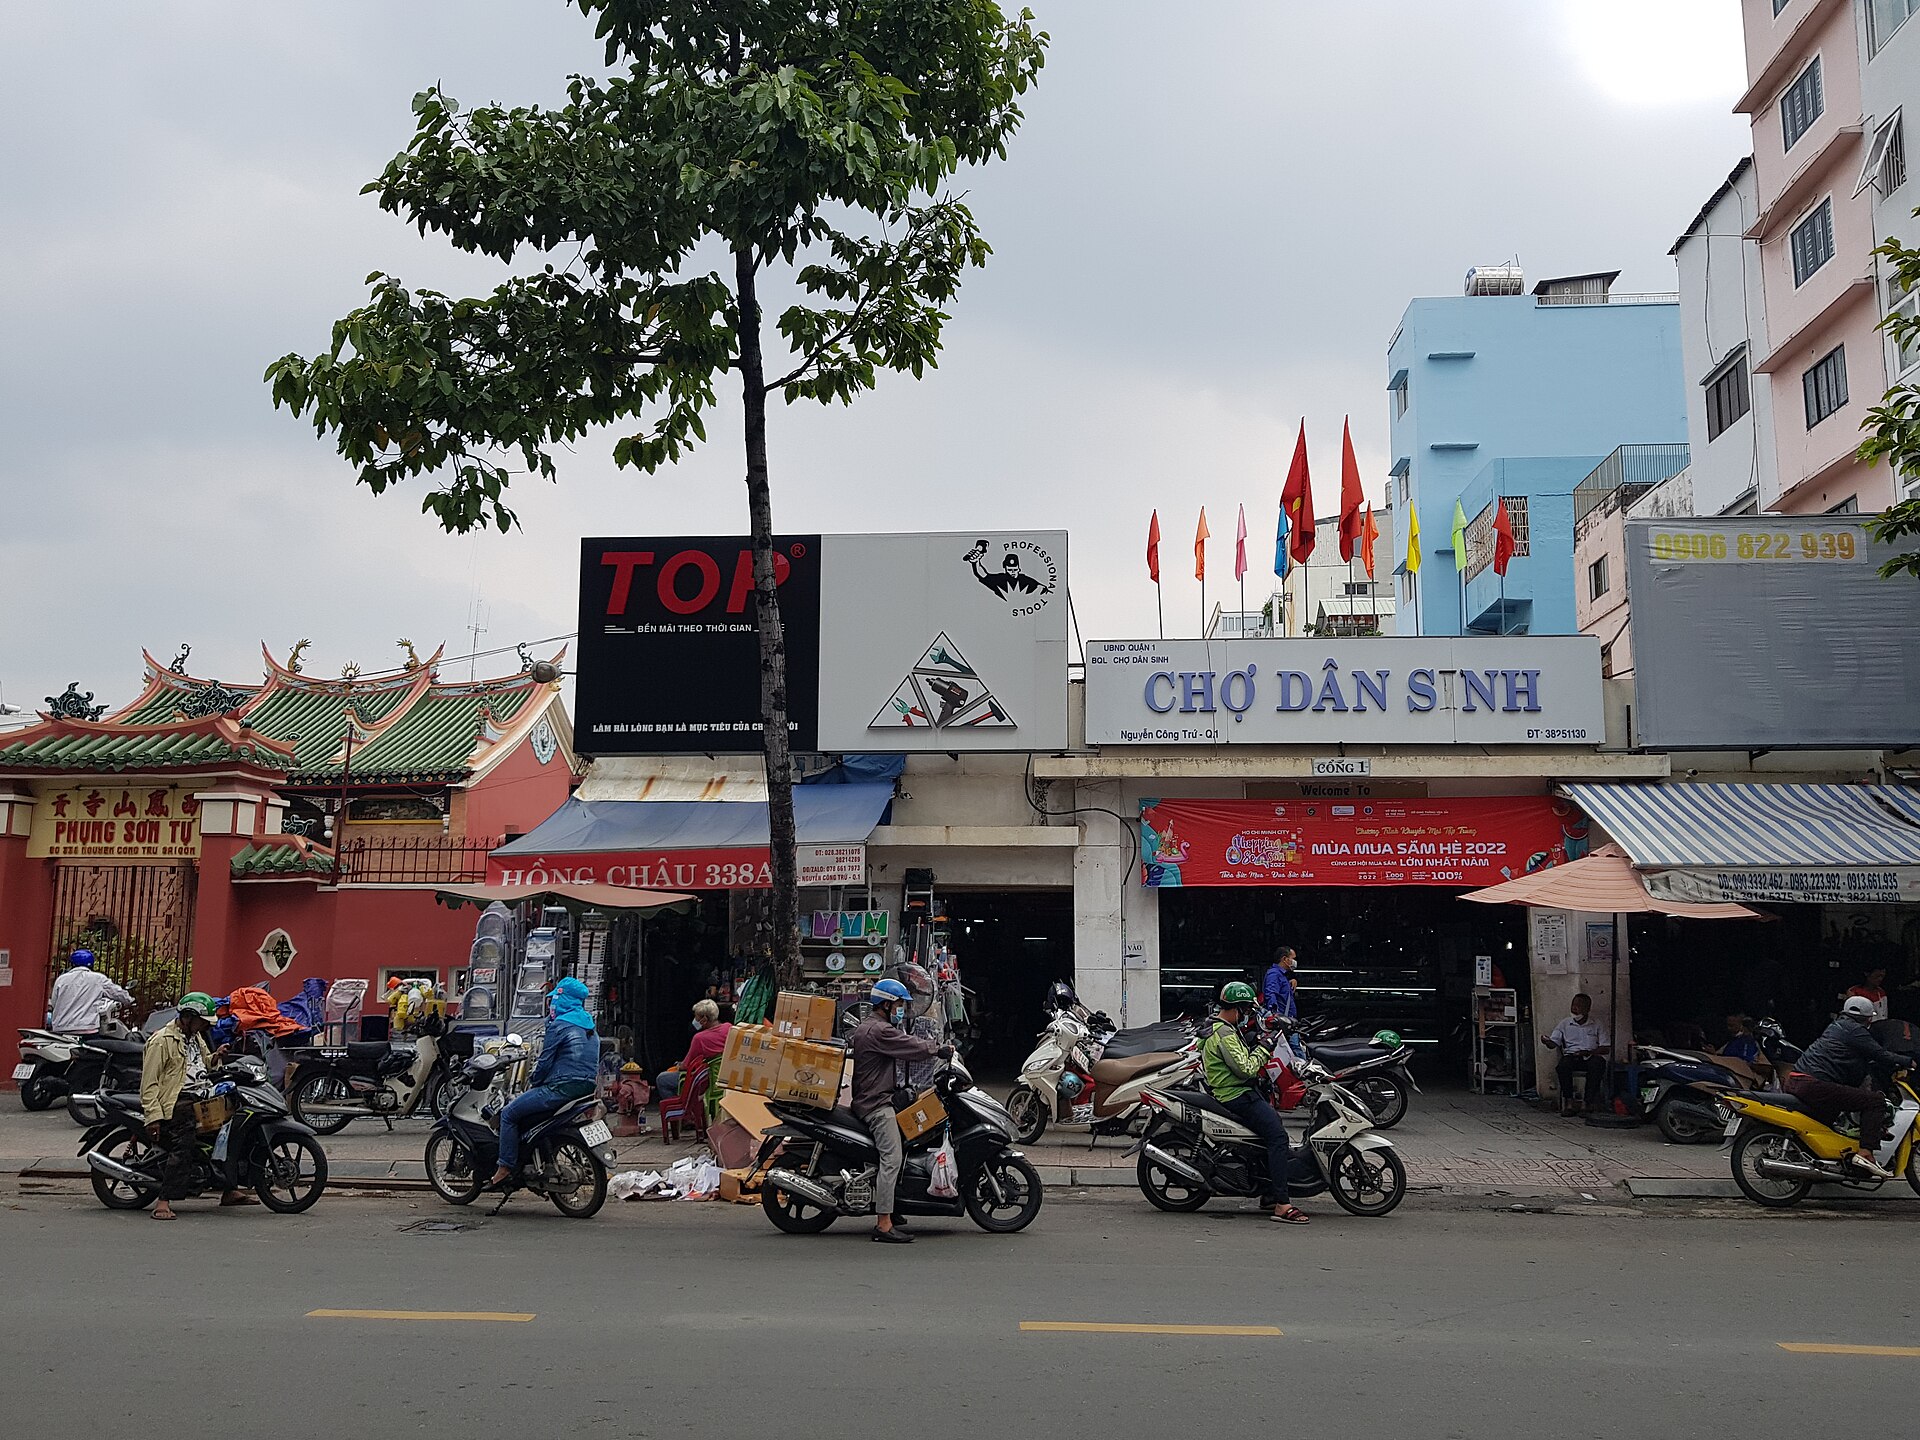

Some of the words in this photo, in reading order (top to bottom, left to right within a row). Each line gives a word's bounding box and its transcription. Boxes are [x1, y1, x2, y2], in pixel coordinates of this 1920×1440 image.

[1654, 532, 1727, 560] 0906
[1736, 532, 1792, 559] 822
[1800, 531, 1855, 560] 939
[600, 549, 791, 615] TOP
[1012, 598, 1048, 616] TOOLS
[677, 624, 703, 633] THEO
[729, 623, 752, 633] GIAN
[1103, 643, 1126, 652] UBND
[1127, 642, 1150, 653] QUẬN
[1152, 643, 1156, 652] 1
[1091, 656, 1108, 665] BQL
[1113, 656, 1130, 667] CHỢ
[1132, 655, 1149, 664] DÂN
[1150, 656, 1169, 665] SINH
[1144, 663, 1257, 723] CHỢ
[1276, 657, 1390, 713] DÂN
[655, 723, 674, 734] BẠN
[675, 722, 687, 732] LÀ
[689, 722, 708, 734] MỤC
[710, 722, 731, 732] TIÊU
[732, 720, 750, 732] CỦA
[1120, 729, 1154, 742] Nguyễn
[1155, 729, 1180, 742] Công
[1182, 728, 1198, 740] Trứ
[1316, 759, 1355, 774] CỔNG
[1359, 761, 1366, 774] 1
[1300, 784, 1350, 797] Welcome
[1356, 784, 1371, 796] To
[55, 820, 116, 845] PHỤNG
[123, 818, 161, 844] SƠN
[168, 818, 197, 846] TỰ
[1311, 839, 1351, 855] MÙA
[1354, 842, 1394, 855] MUA
[1397, 838, 1437, 855] SẮM
[1439, 839, 1464, 855] HÈ
[1465, 843, 1507, 855] 2022
[1399, 856, 1424, 867] LỚN
[1425, 856, 1459, 867] NHẤT
[1461, 857, 1490, 867] NĂM
[501, 857, 595, 887] HỒNG
[606, 857, 697, 888] CHÂU
[705, 862, 772, 887] 338A
[1431, 871, 1463, 880] 100%
[1732, 873, 1784, 890] 090.3332.462
[1790, 872, 1841, 890] 0983.223.992
[1847, 872, 1898, 890] 0913.661.935
[1235, 990, 1251, 998] Grab
